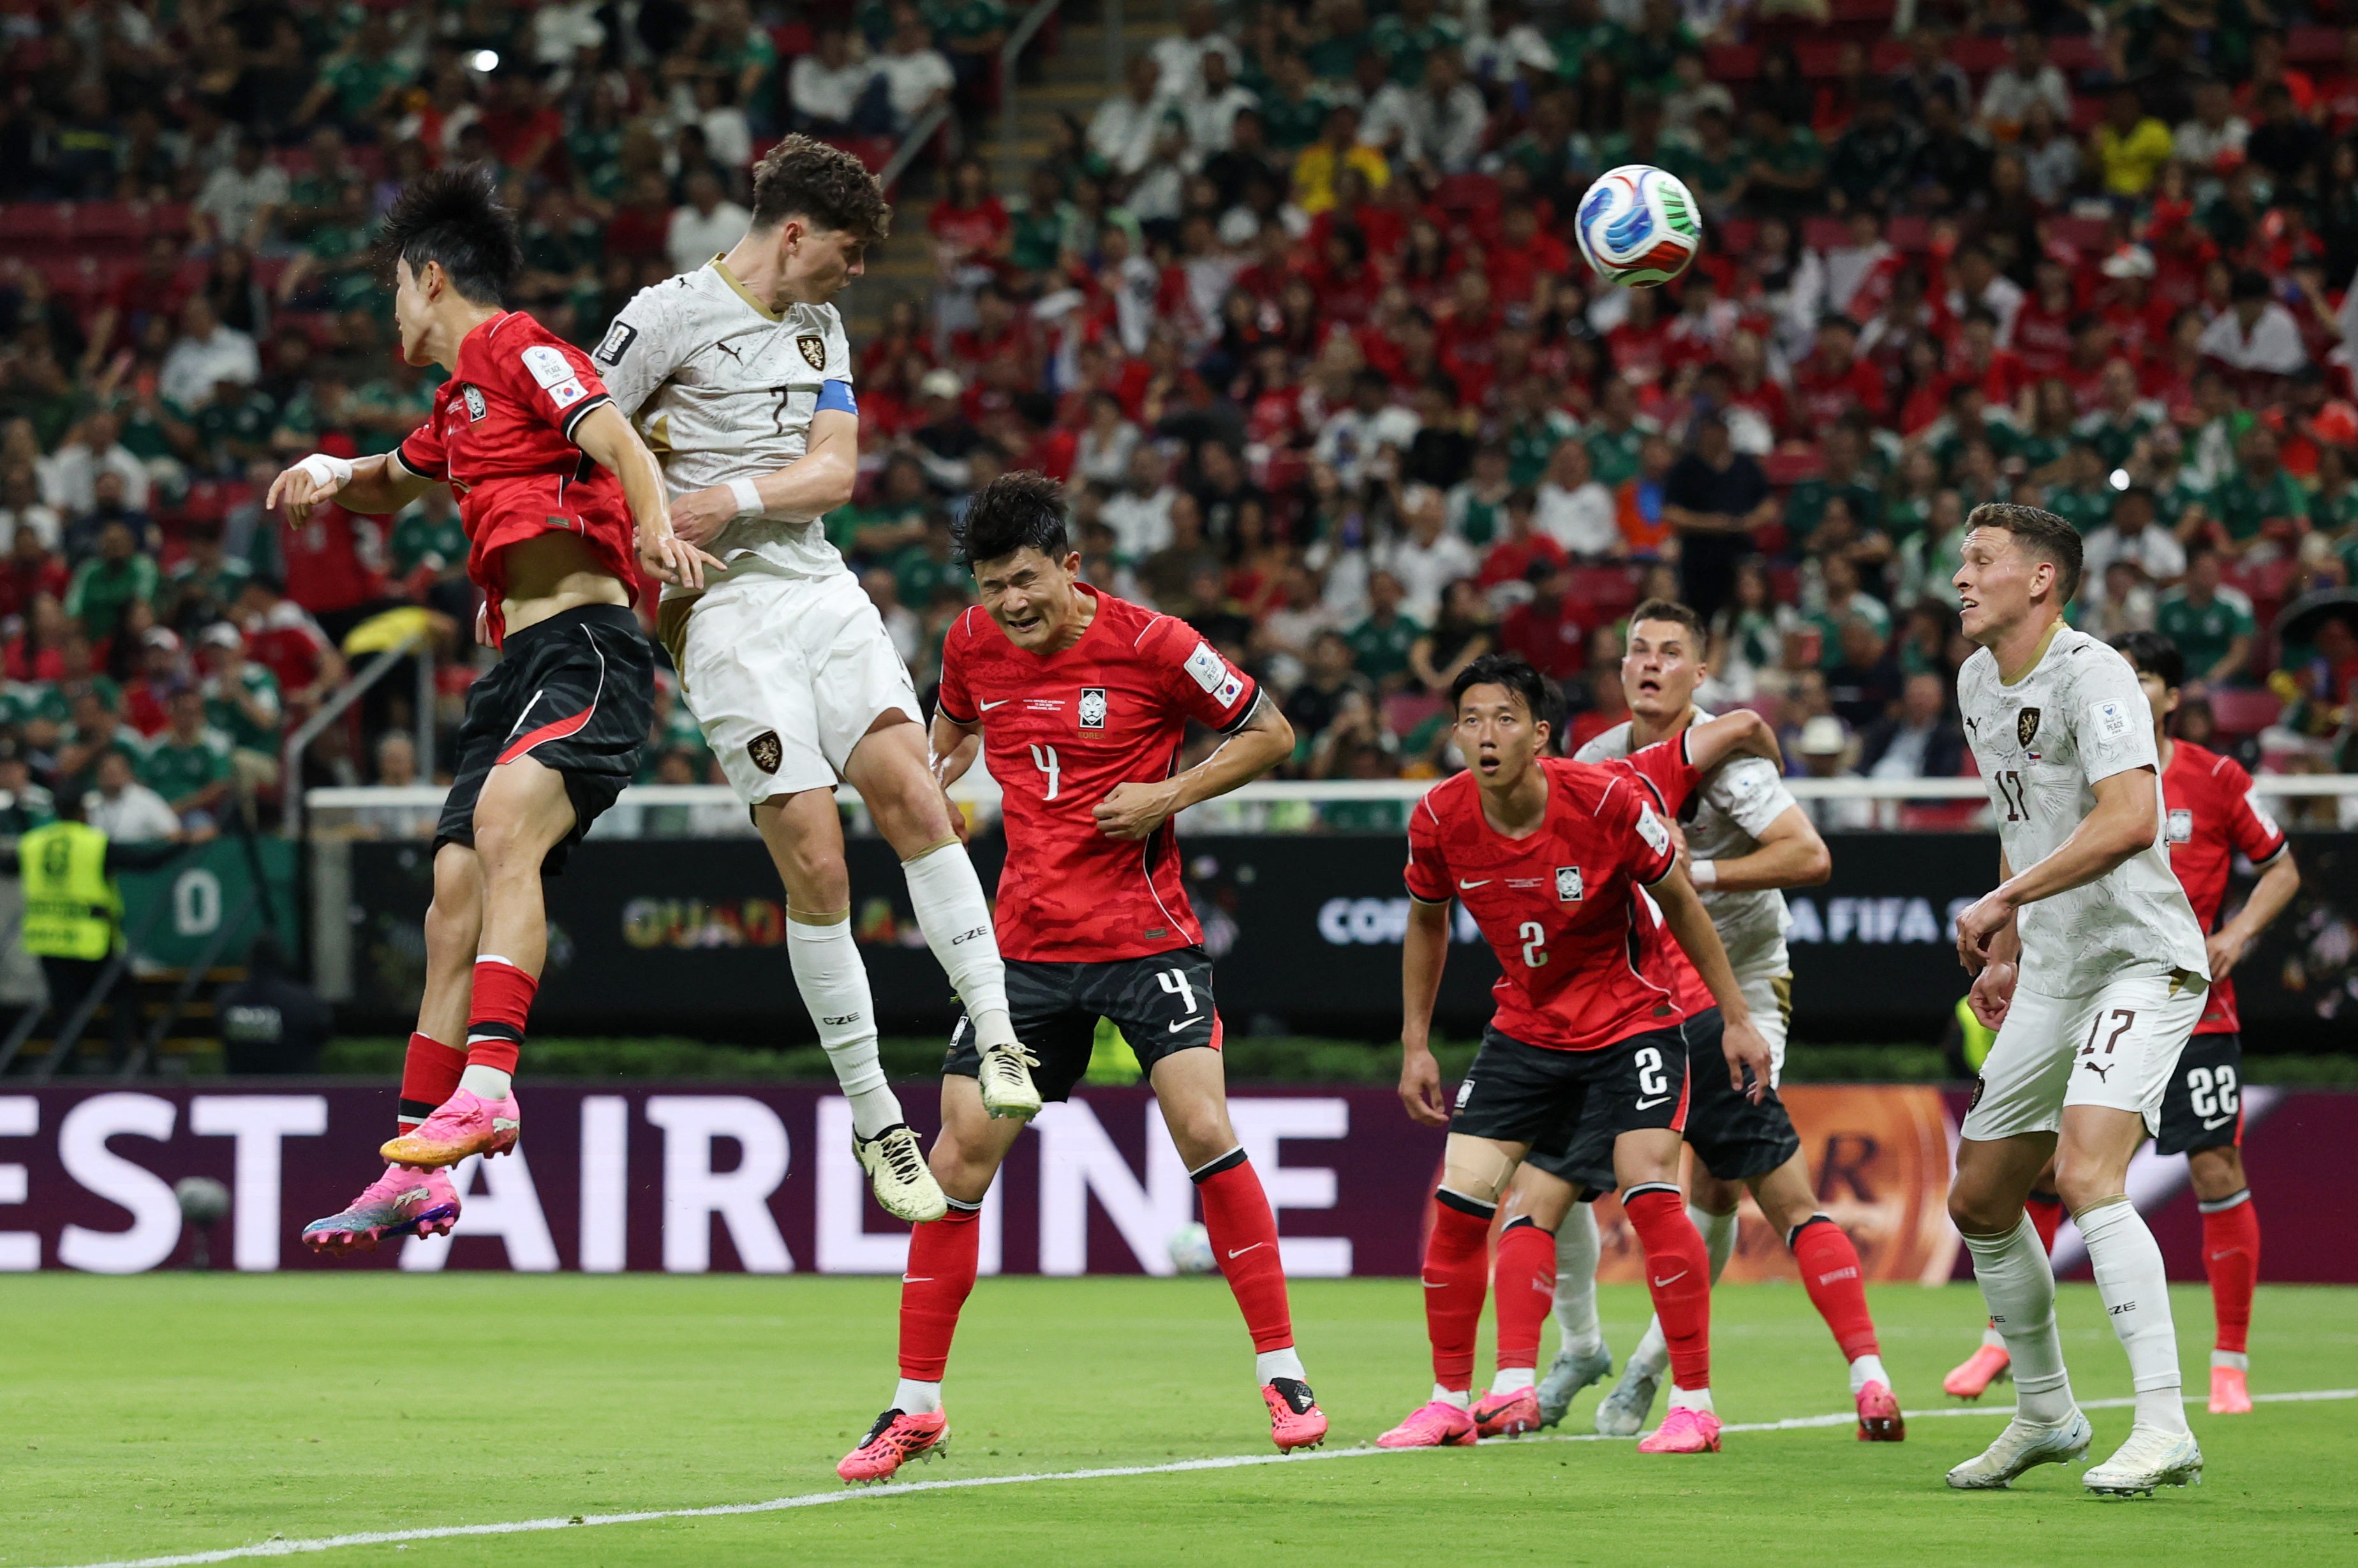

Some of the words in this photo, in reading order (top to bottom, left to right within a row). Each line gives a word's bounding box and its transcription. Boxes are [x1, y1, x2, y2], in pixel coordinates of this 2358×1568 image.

[769, 384, 788, 434] 7
[1078, 731, 1106, 739] KOREA
[1028, 744, 1061, 801] 4
[1994, 771, 2030, 822] 17
[952, 925, 988, 945] CZE
[1826, 896, 1939, 944] FIFA
[1519, 921, 1548, 968] 2
[1154, 968, 1198, 1014] 4
[822, 1011, 860, 1025] CZE
[2081, 1009, 2137, 1056] 17
[1635, 1047, 1668, 1095] 2
[2186, 1064, 2239, 1118] 22
[398, 1094, 1353, 1278] AIRLNE
[2107, 1301, 2136, 1316] CZE
